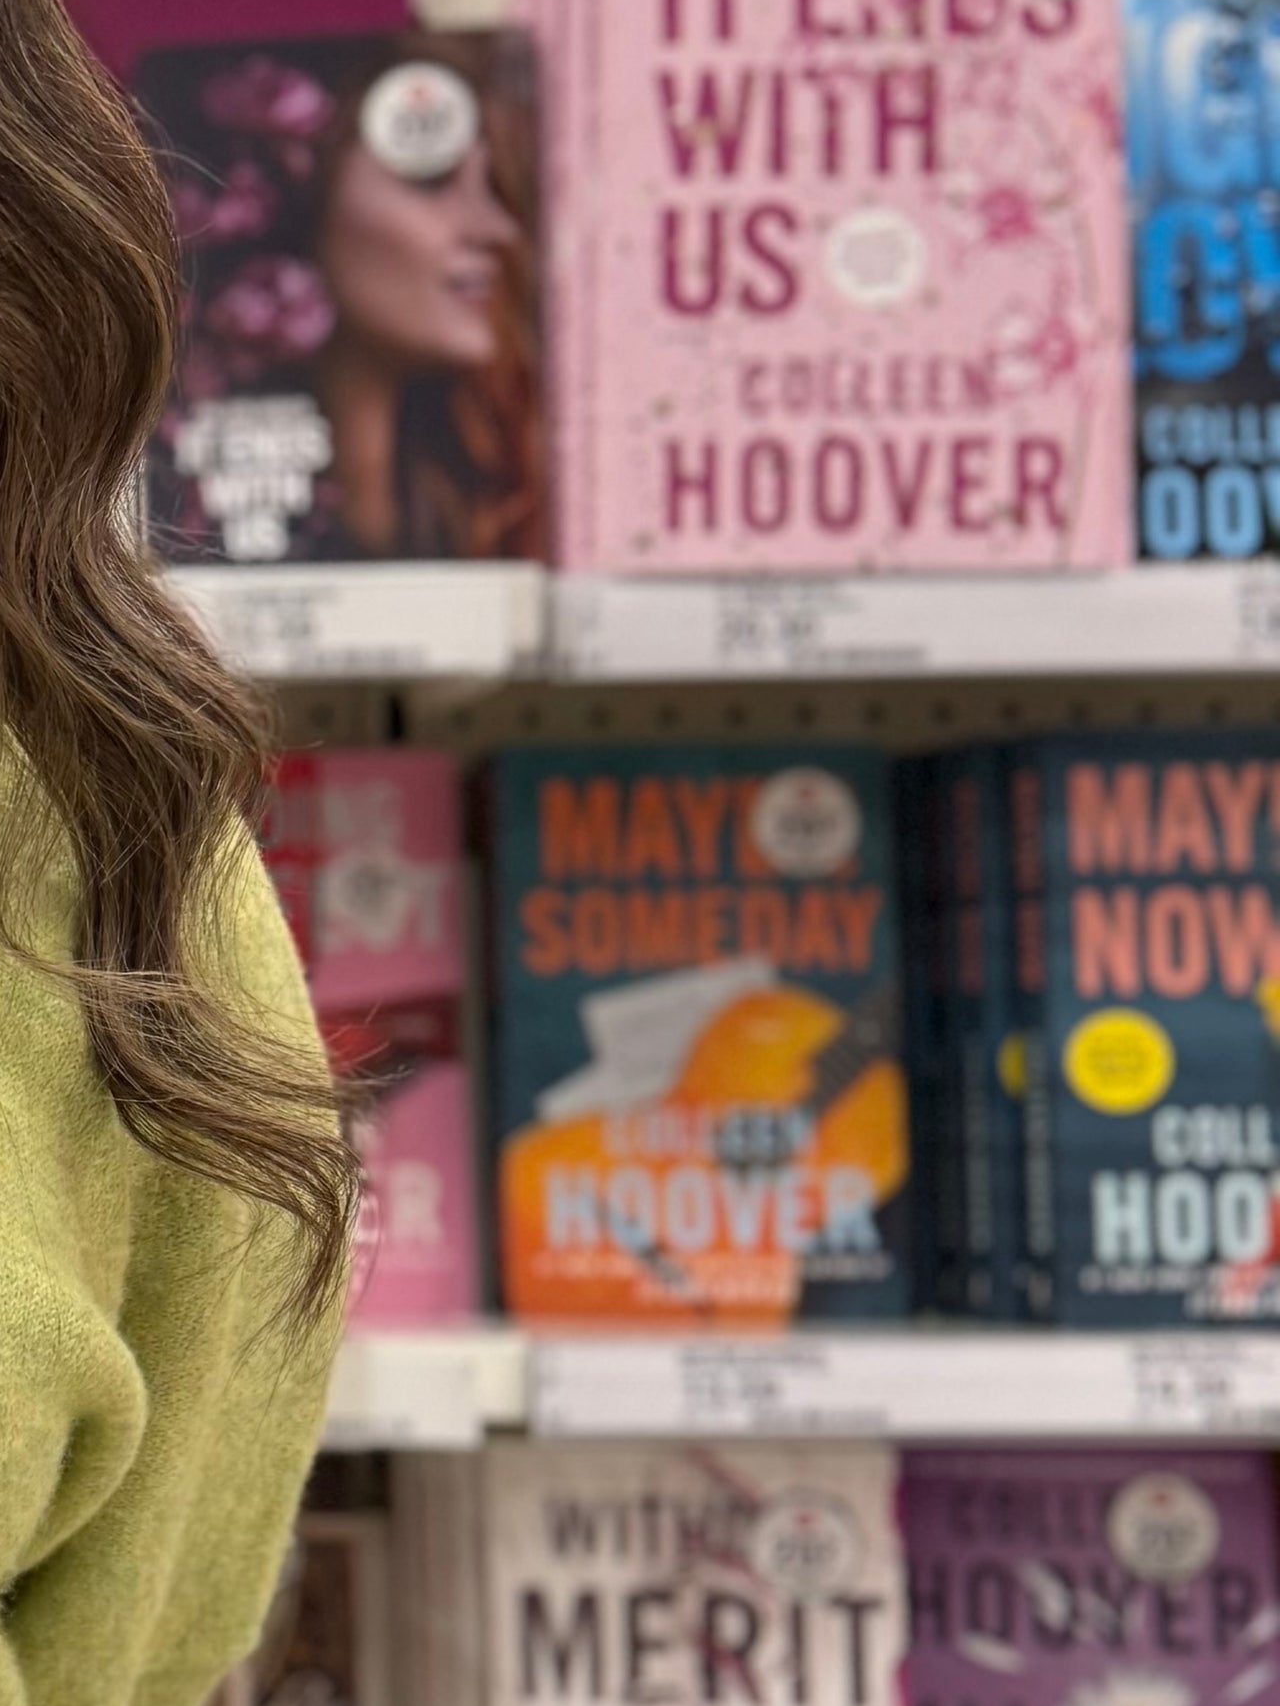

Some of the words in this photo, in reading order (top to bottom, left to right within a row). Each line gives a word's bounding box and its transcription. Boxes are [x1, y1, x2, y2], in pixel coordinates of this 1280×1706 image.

[656, 63, 942, 181] WITH
[658, 201, 802, 319] US
[738, 351, 996, 421] COLLEEN
[662, 435, 1068, 537] HOOVER
[1064, 761, 1280, 877] MAY
[518, 887, 882, 977] SOMEDAY
[544, 1165, 882, 1255] HOOVER
[1090, 1169, 1280, 1267] HOO
